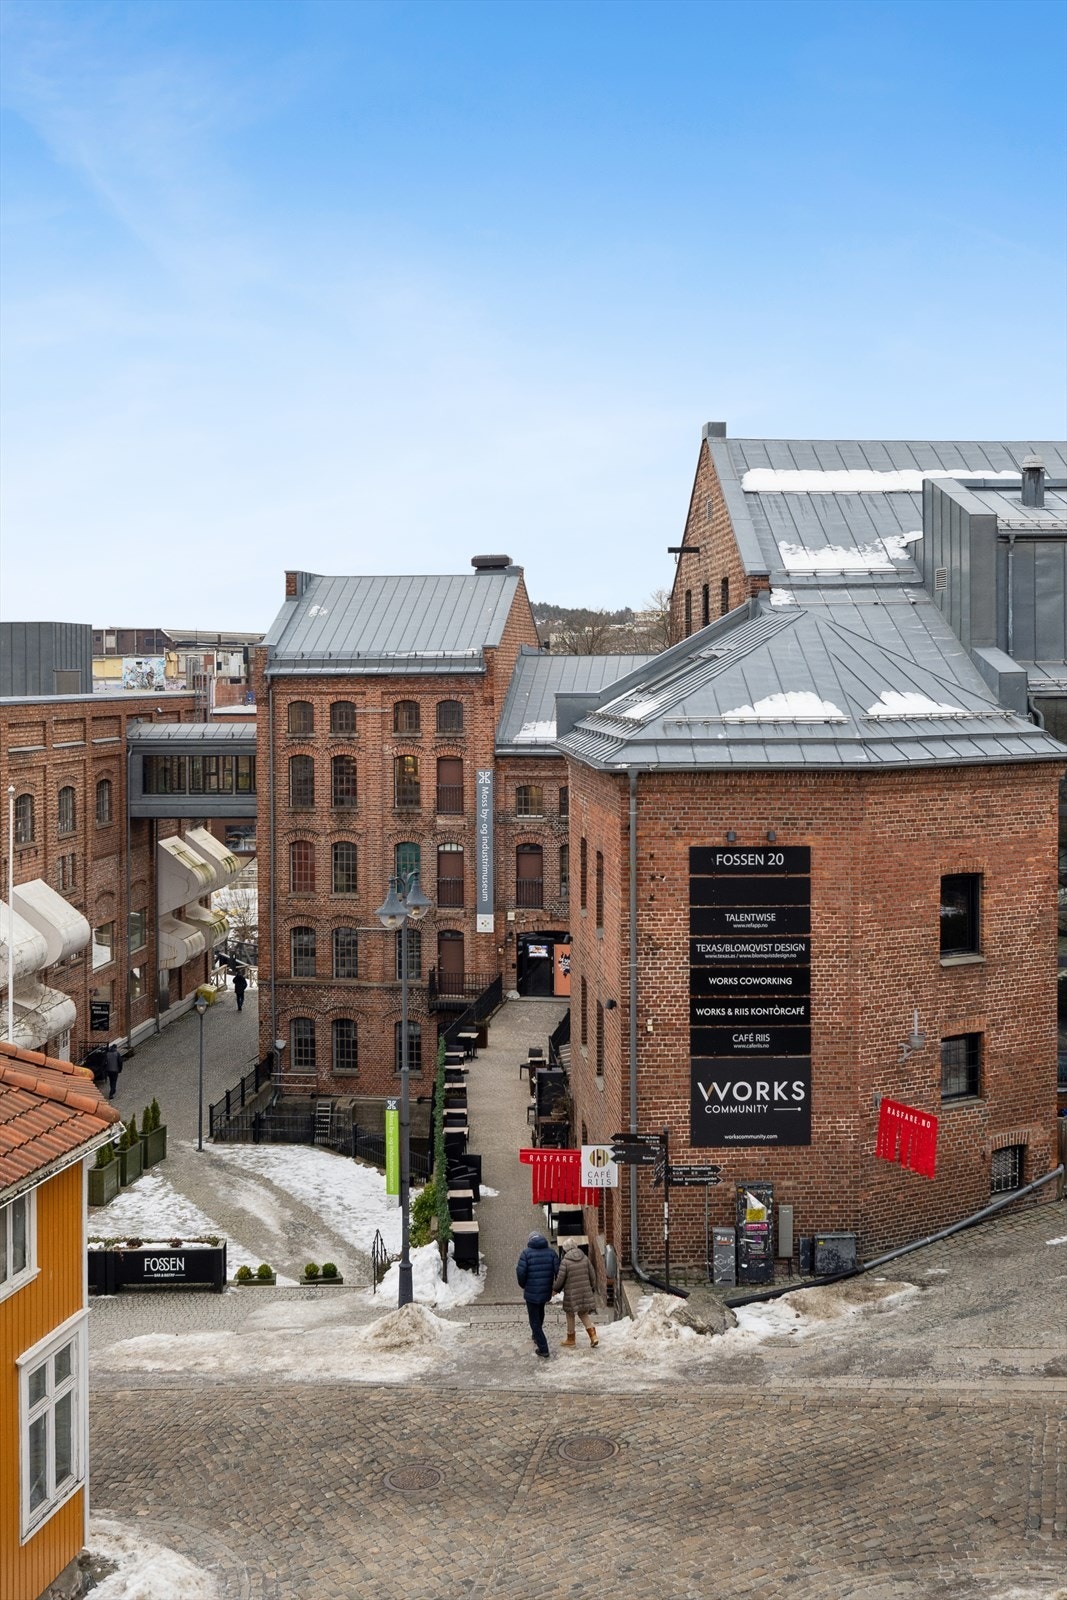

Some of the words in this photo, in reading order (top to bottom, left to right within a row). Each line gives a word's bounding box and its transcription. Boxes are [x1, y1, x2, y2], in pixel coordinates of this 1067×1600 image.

[480, 808, 490, 822] by-
[480, 824, 487, 834] og
[716, 854, 764, 866] FOSSEN
[768, 853, 784, 866] 20
[482, 836, 490, 902] industrimuseum
[725, 913, 776, 922] TALENTWISE
[696, 944, 773, 952] TEXAS/BLOMQVIST
[774, 944, 806, 952] DESIGN
[708, 977, 738, 985] WORKS
[740, 977, 792, 985] COWORKING
[732, 1033, 754, 1042] CAFÉ
[756, 1034, 770, 1042] RIIS
[697, 1081, 806, 1102] WORKS
[705, 1104, 768, 1114] COMMUNITY
[886, 1106, 930, 1128] RASFARE.NO
[530, 1154, 581, 1163] RASFARE.
[588, 1170, 611, 1178] CAFÉ
[144, 1258, 185, 1271] FOSSEN
